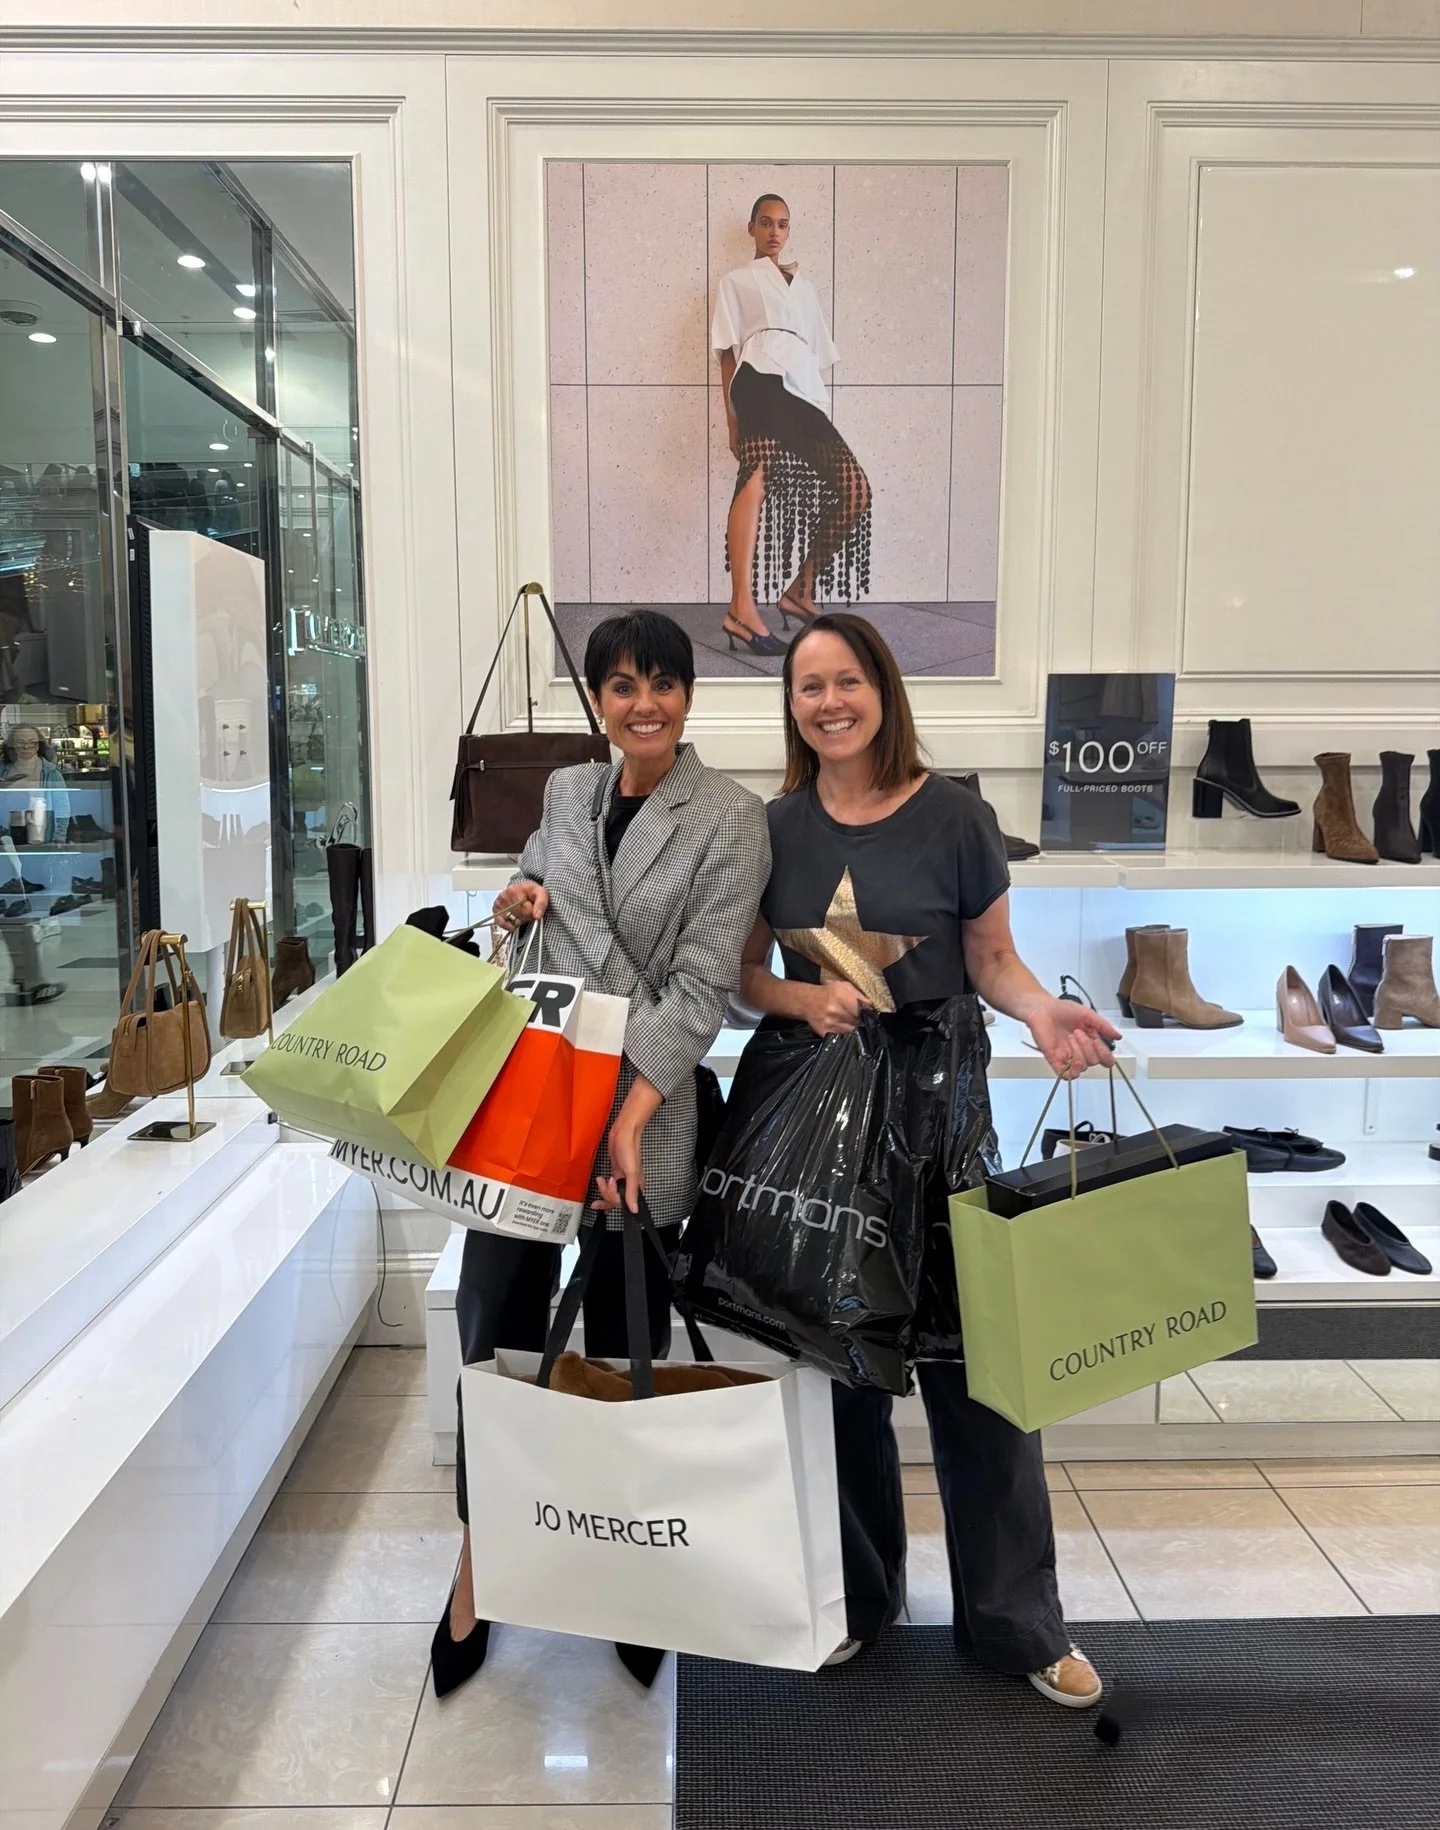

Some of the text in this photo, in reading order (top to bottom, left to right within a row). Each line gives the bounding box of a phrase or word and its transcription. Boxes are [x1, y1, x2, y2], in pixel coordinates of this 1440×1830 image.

[1049, 740, 1168, 774] $100 OFF
[1057, 784, 1154, 793] FULL-PRICED BOOTS
[271, 1033, 387, 1072] COUNTRY ROAD
[330, 1139, 505, 1220] MYER.COM.AU
[697, 1166, 889, 1248] ortmans
[718, 1297, 787, 1330] portmans.com
[1049, 1301, 1227, 1381] COUNTRY ROAD
[535, 1501, 690, 1548] JO MERCER
